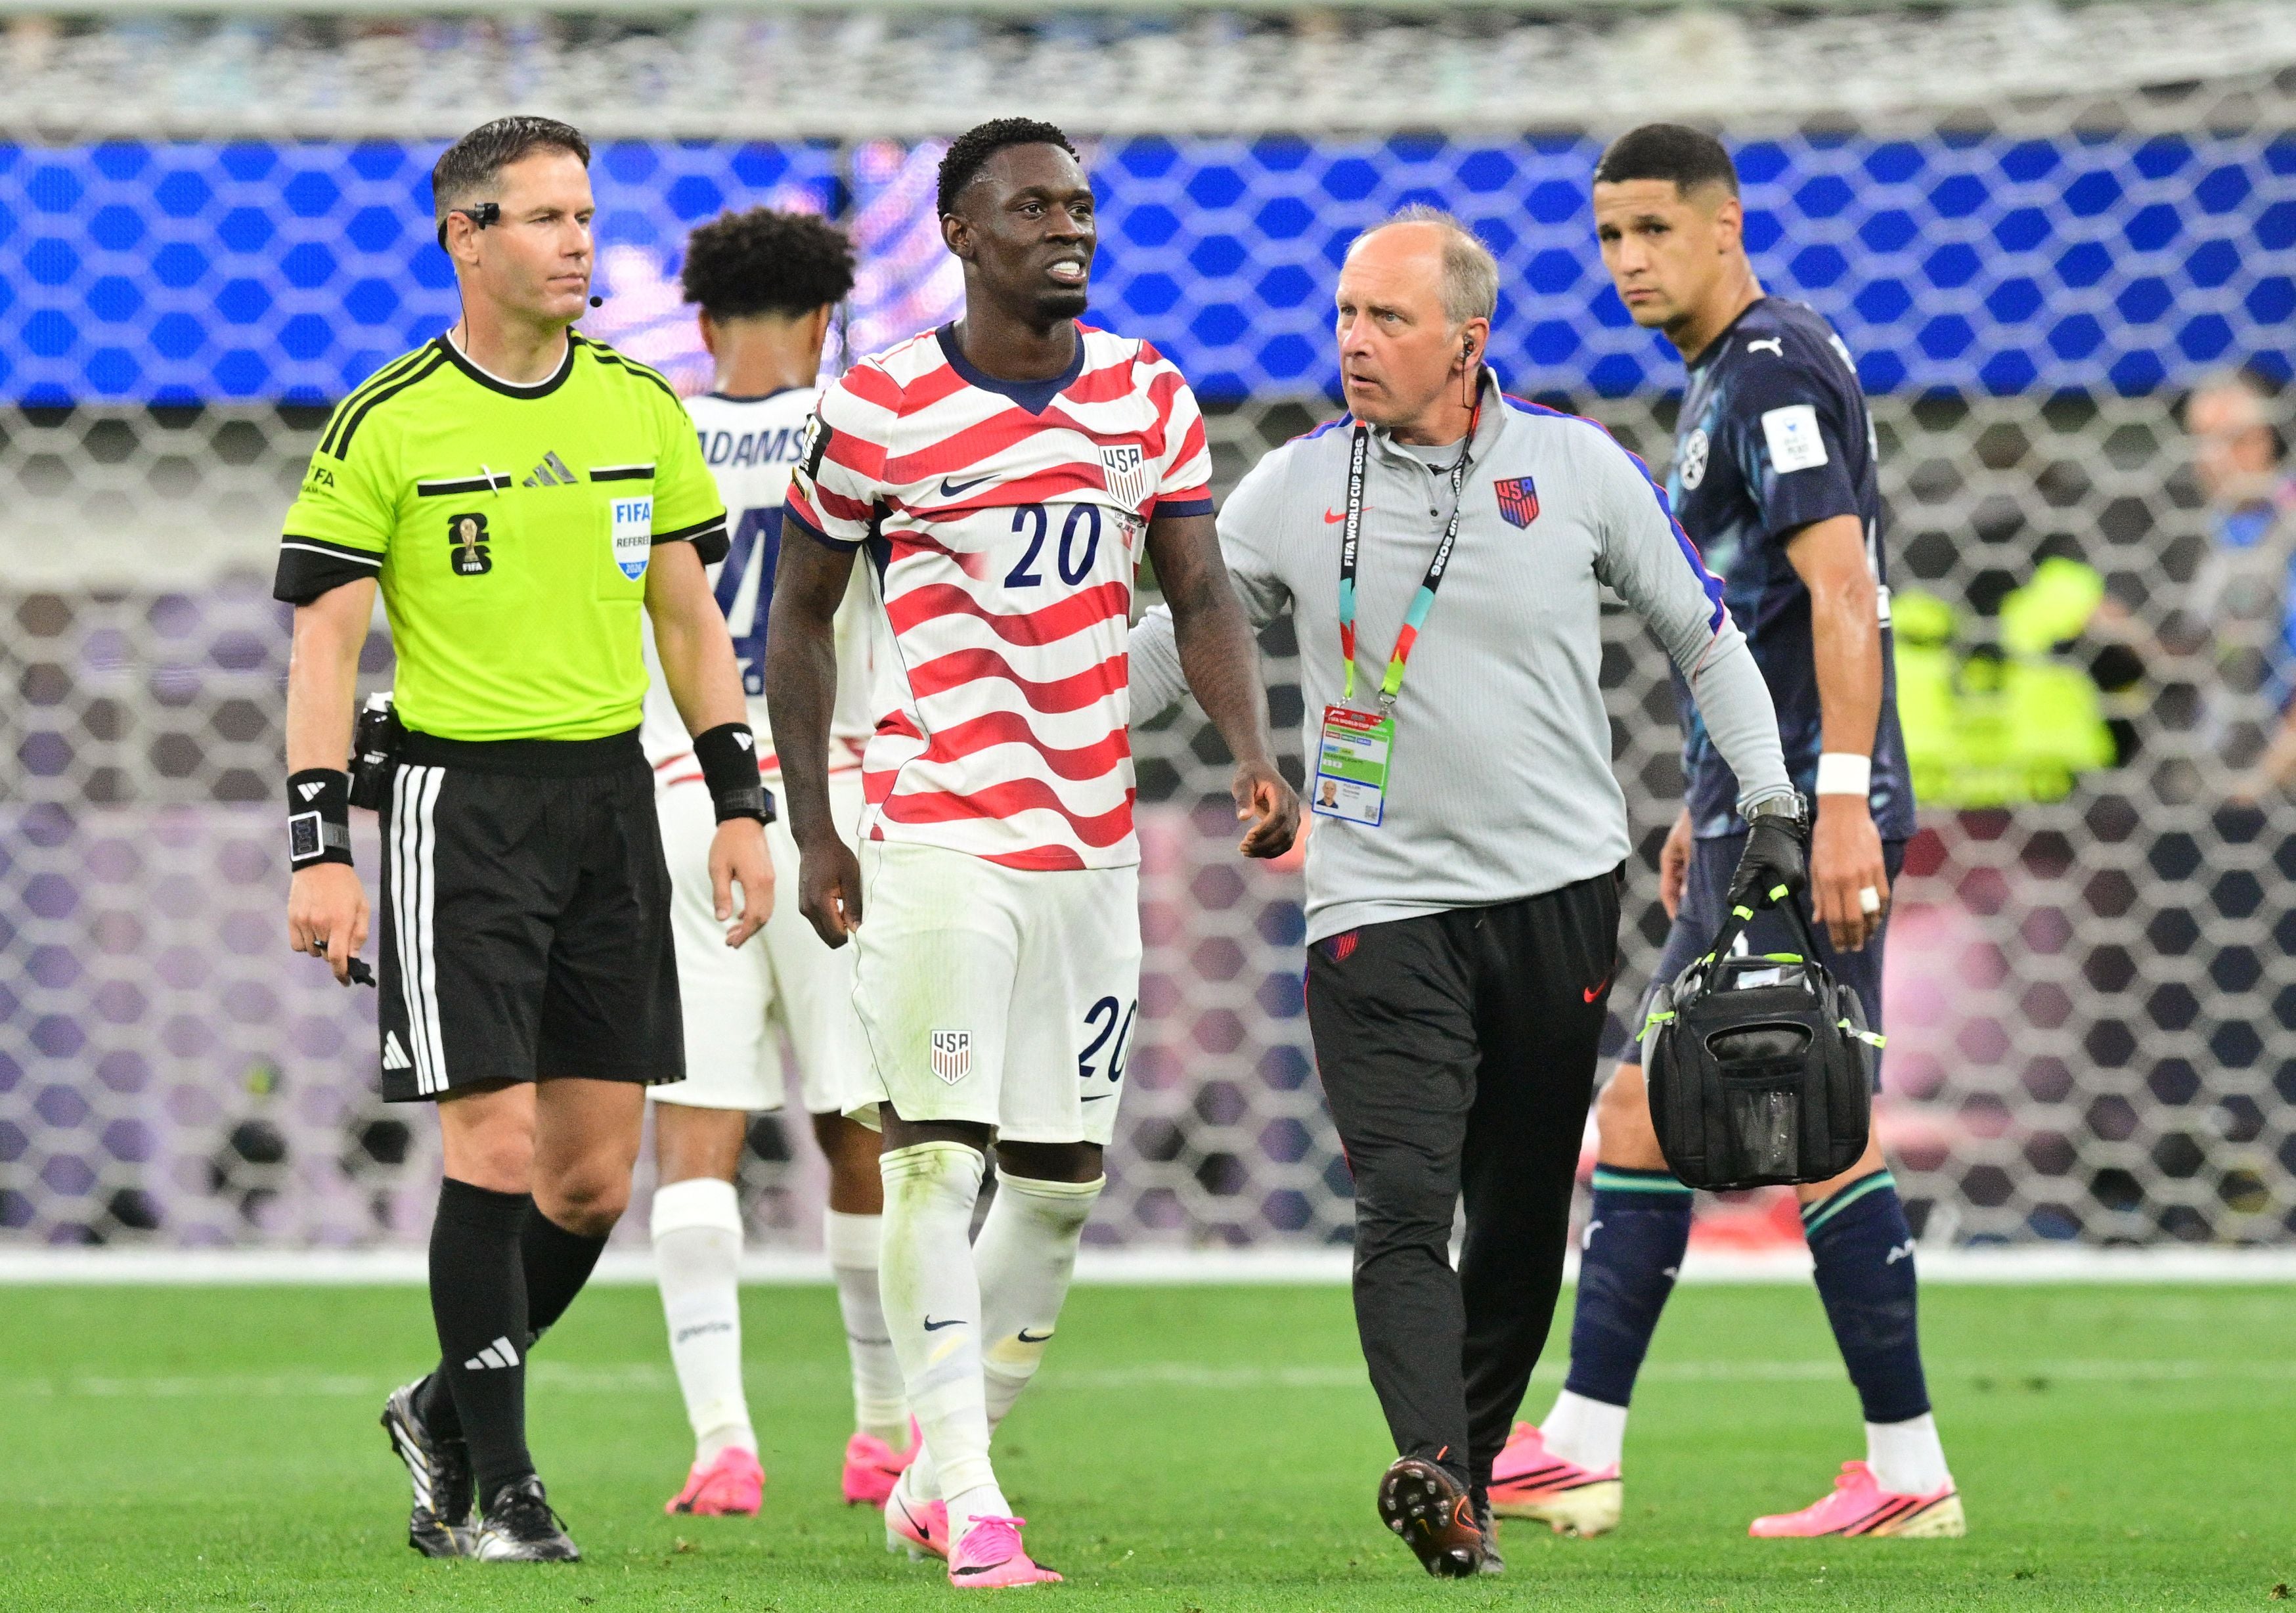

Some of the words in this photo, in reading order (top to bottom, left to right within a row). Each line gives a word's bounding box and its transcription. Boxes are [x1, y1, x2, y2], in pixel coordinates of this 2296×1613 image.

[1103, 448, 1140, 474] USA
[1352, 437, 1365, 475] 2026
[1350, 475, 1361, 497] CUP
[1497, 479, 1533, 500] USA
[616, 502, 651, 523] FIFA
[1346, 498, 1361, 540] WORLD
[1004, 502, 1101, 588] 20
[1344, 540, 1357, 567] FIFA
[1431, 535, 1453, 577] 2026
[462, 562, 483, 572] FIFA
[934, 1033, 969, 1053] USA
[1078, 996, 1137, 1082] 20
